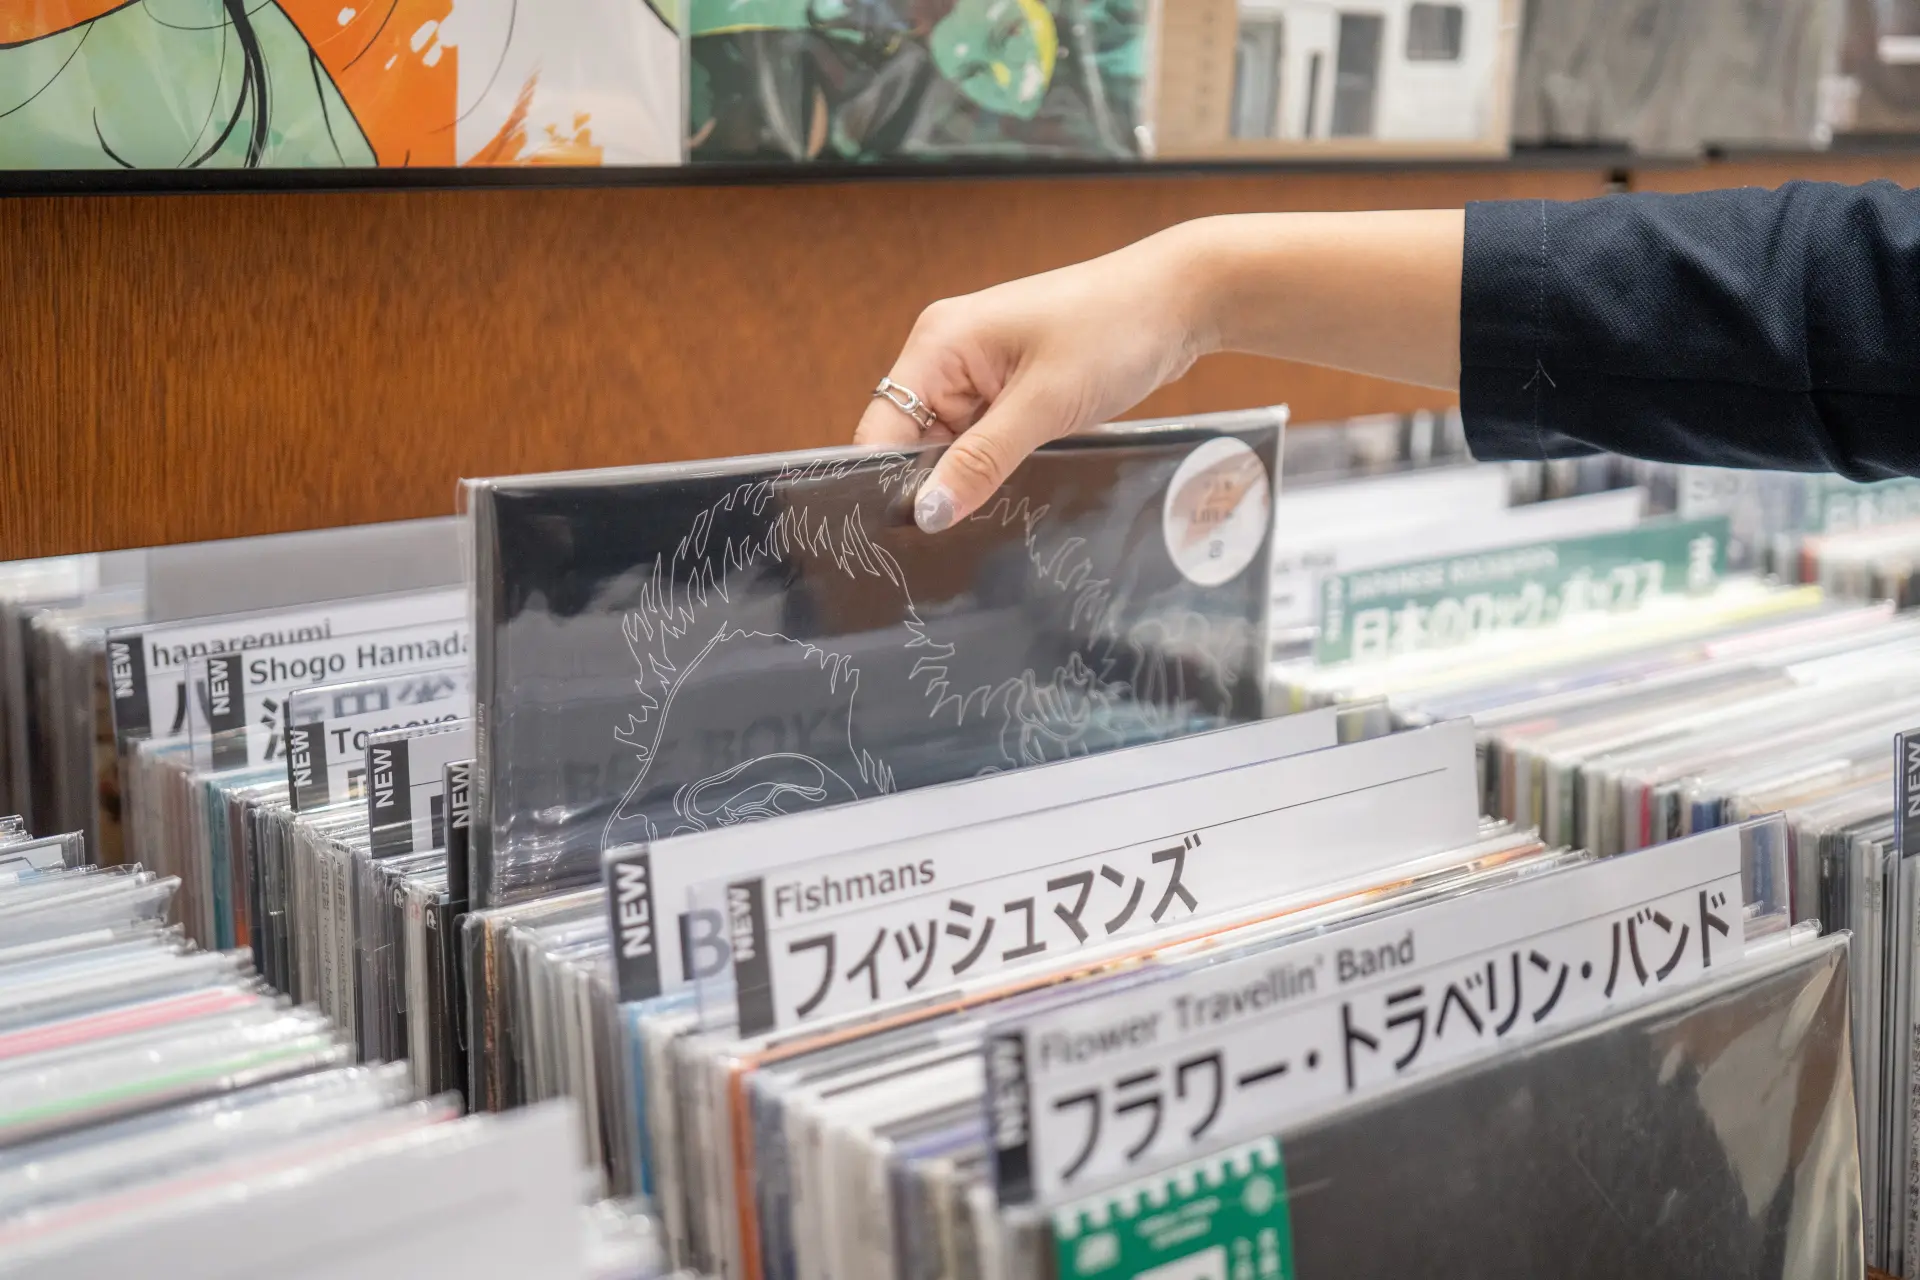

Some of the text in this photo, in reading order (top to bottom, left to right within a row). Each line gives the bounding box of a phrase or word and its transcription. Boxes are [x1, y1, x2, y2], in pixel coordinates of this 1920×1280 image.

[112, 642, 135, 699] NEW
[210, 659, 231, 716] NEW
[249, 653, 345, 685] Shogo
[290, 729, 313, 788] NEW
[373, 748, 395, 809] NEW
[451, 763, 471, 829] NEW
[614, 862, 652, 960] NEW
[773, 857, 936, 918] Fishmans
[728, 884, 756, 962] NEW
[788, 833, 1203, 1018] フィッシュマンズ
[1041, 1011, 1160, 1067] Flower
[1336, 930, 1415, 983] Band
[1052, 890, 1731, 1181] フラワー・トラベリン・バンド
